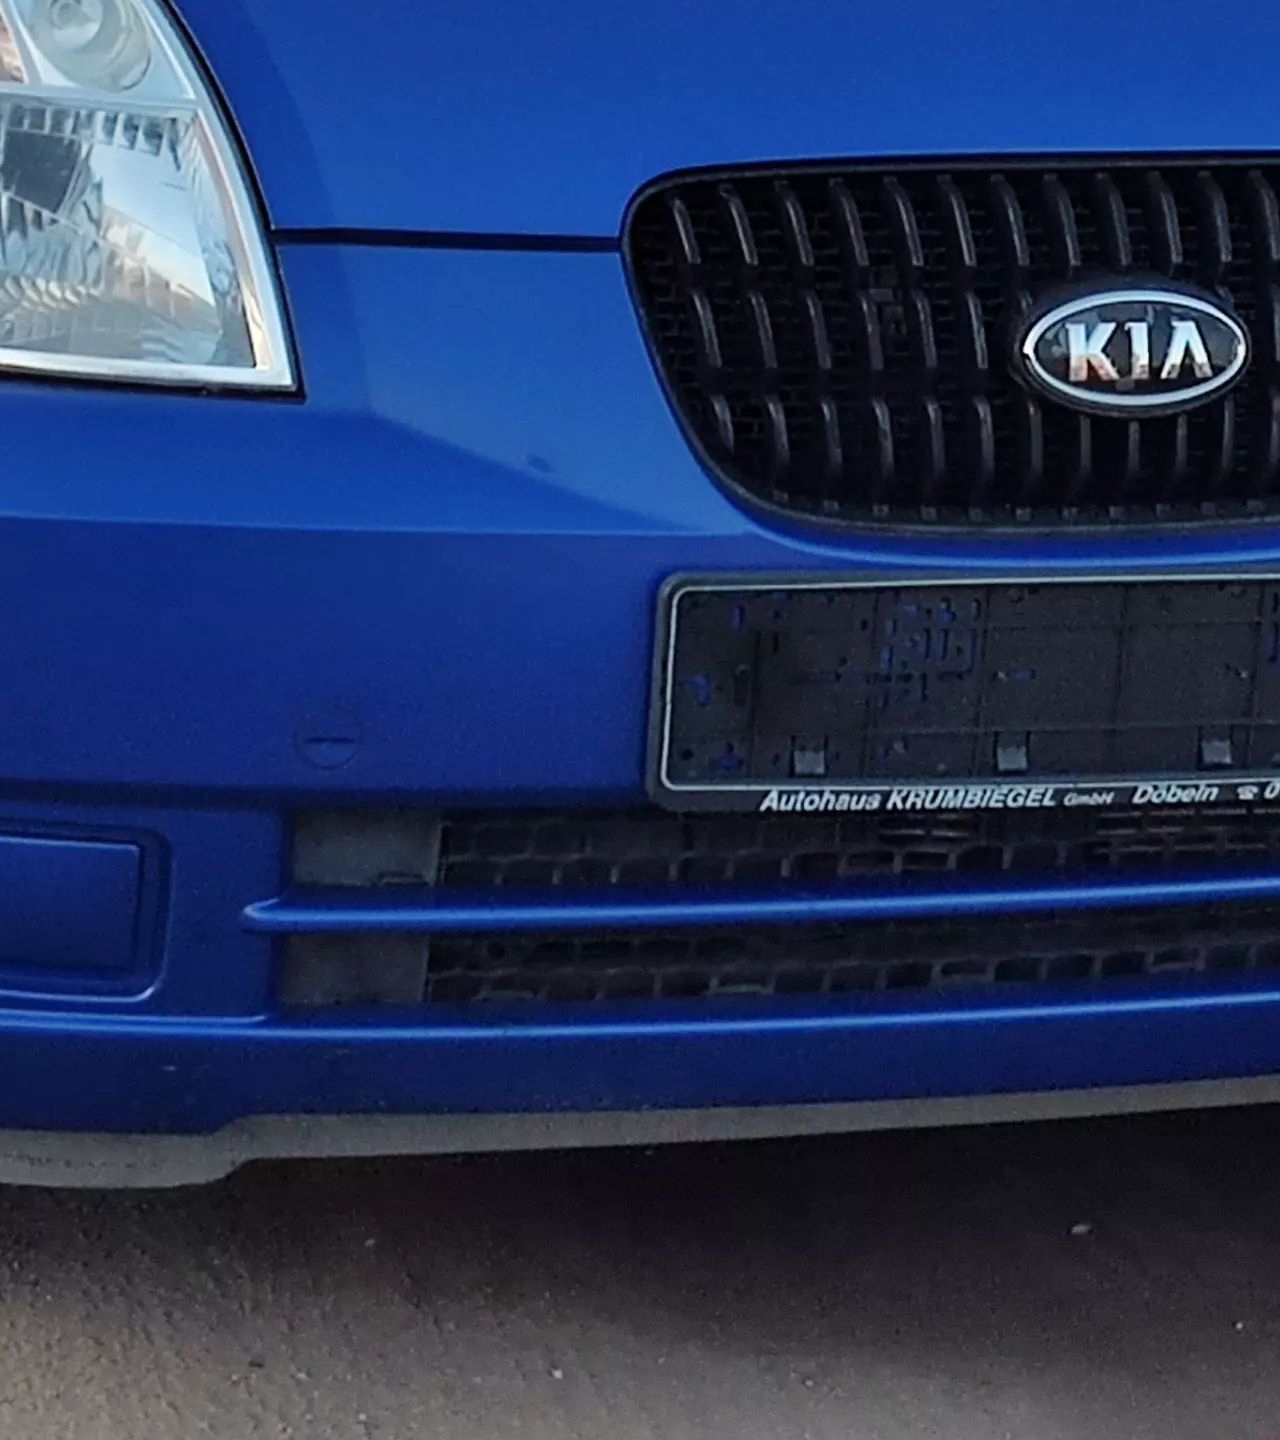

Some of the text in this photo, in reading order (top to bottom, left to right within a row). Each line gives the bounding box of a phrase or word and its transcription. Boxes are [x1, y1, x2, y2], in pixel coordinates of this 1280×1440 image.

[1065, 319, 1214, 382] KIA
[759, 788, 882, 812] Autohaus
[886, 785, 1056, 811] KRUMBIEGEL
